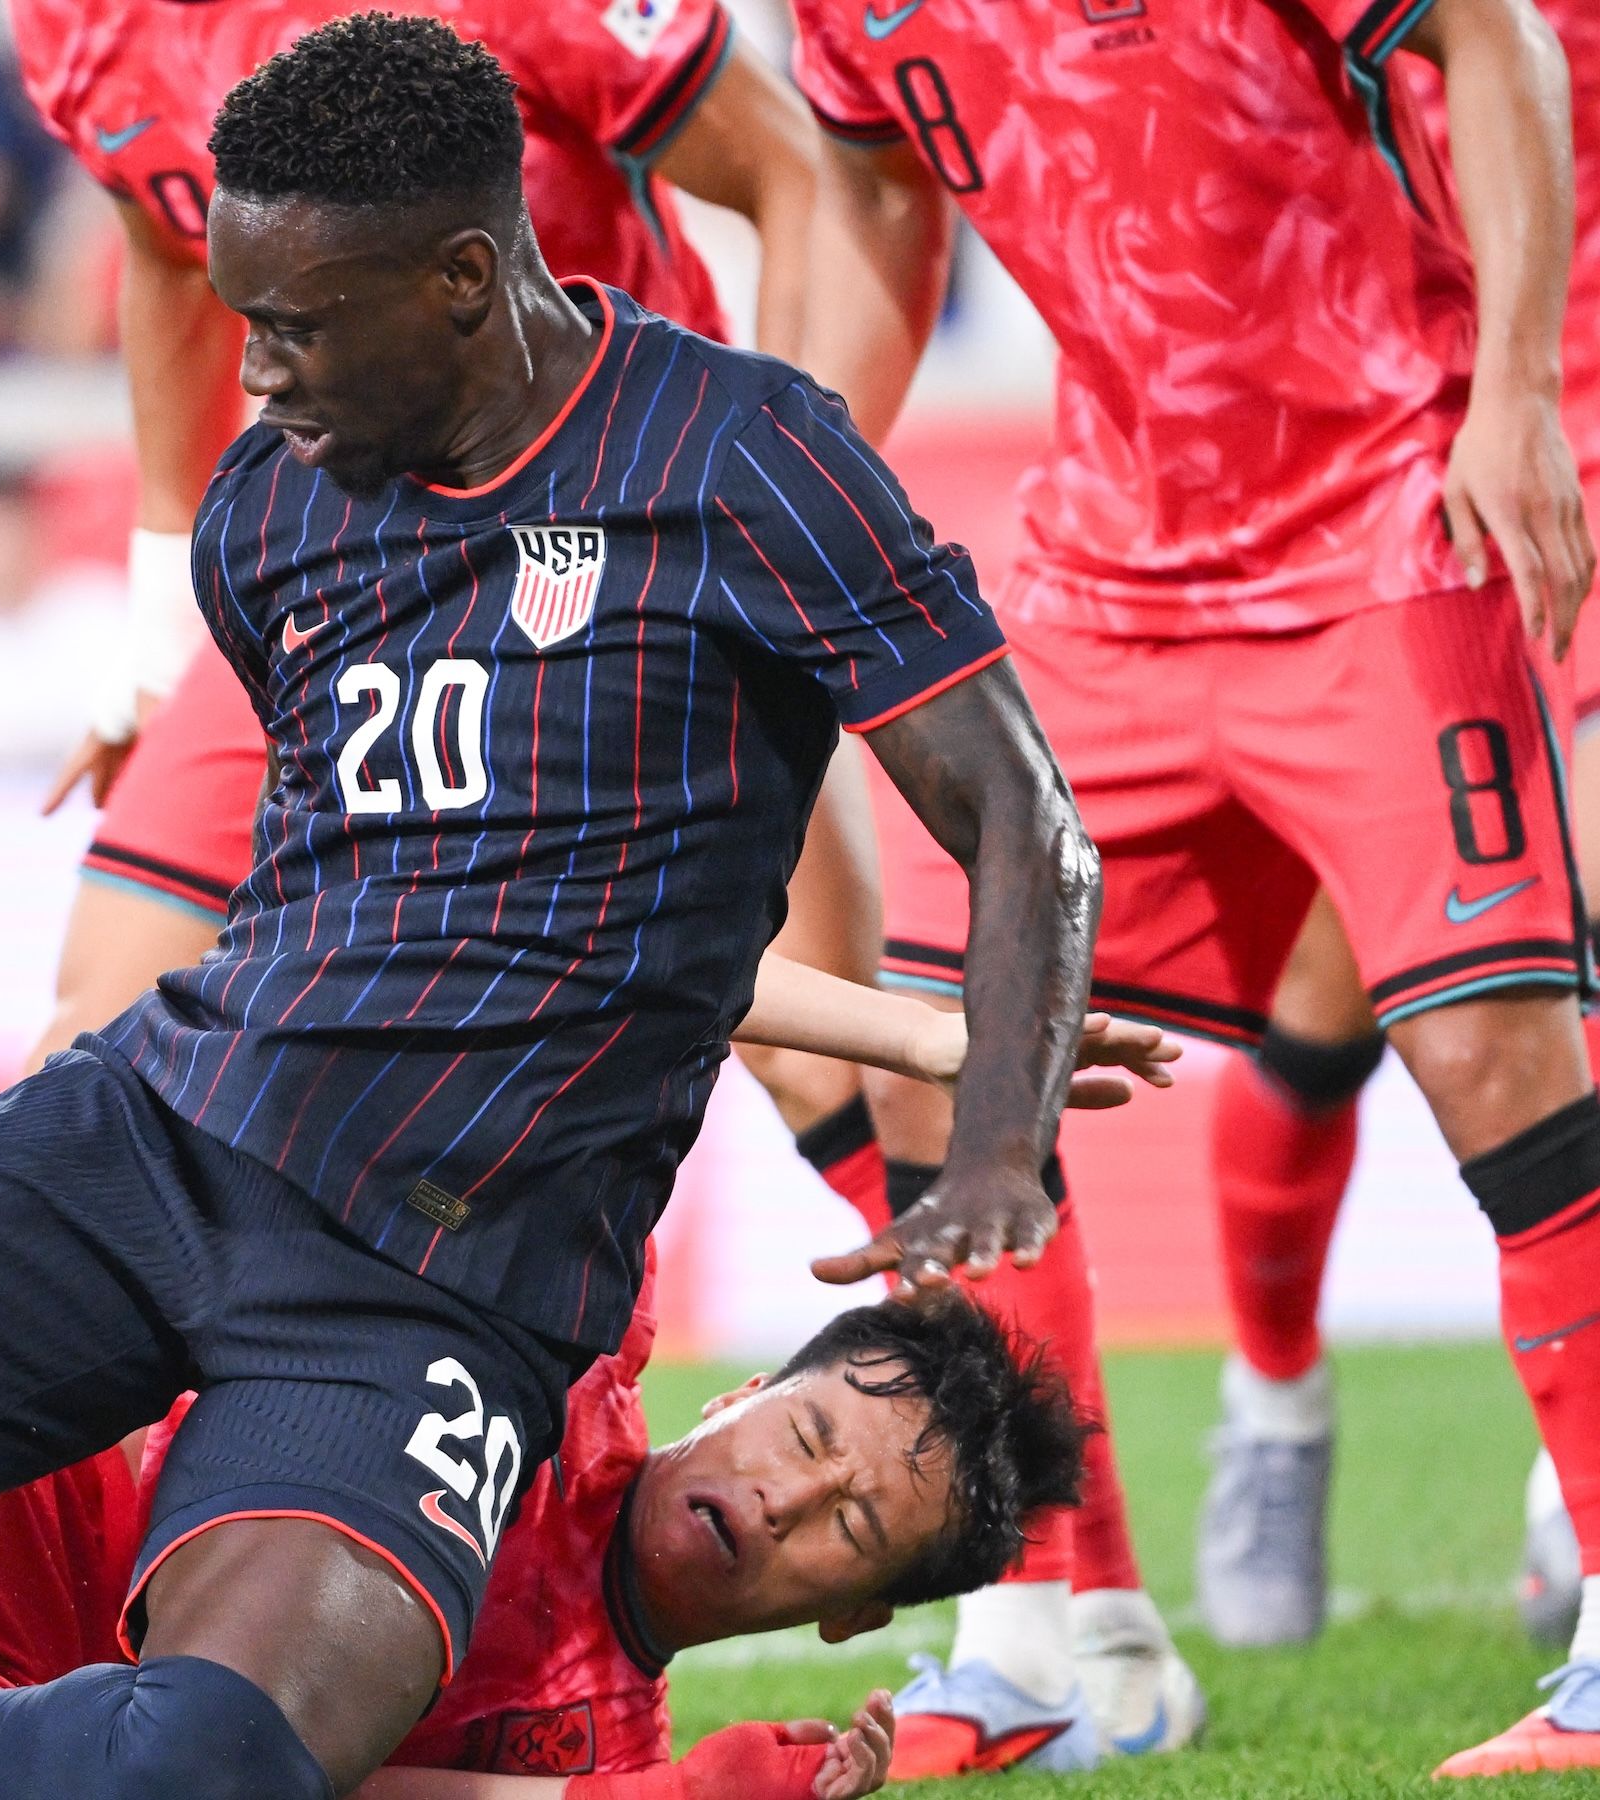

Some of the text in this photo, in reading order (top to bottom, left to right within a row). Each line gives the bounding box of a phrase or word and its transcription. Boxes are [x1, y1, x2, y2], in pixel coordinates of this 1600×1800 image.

[895, 57, 984, 193] 8
[519, 531, 599, 576] USA
[337, 659, 489, 813] 20
[1438, 720, 1526, 865] 8
[405, 1356, 521, 1561] 20
